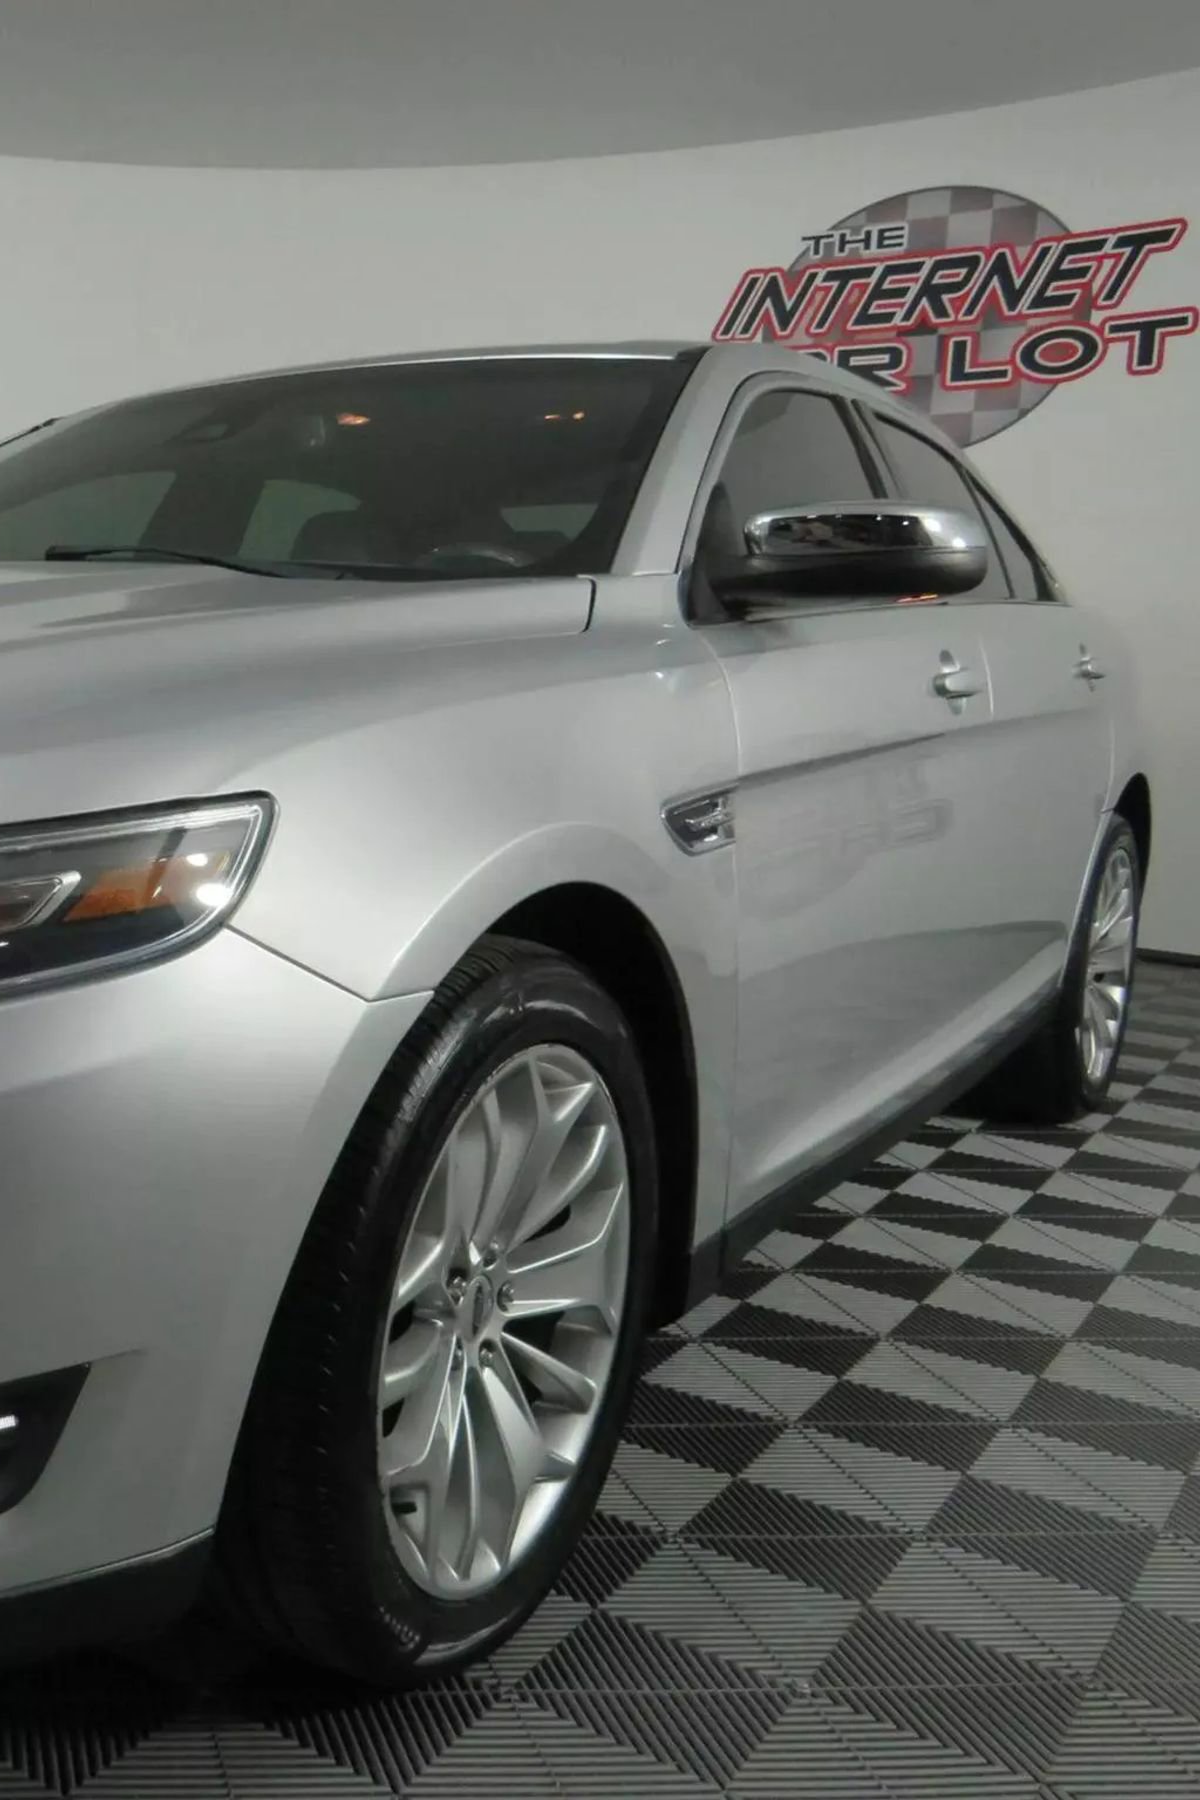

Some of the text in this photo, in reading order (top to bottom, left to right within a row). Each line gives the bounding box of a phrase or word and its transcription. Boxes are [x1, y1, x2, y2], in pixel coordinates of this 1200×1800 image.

[714, 220, 1187, 341] INTERNET
[801, 224, 908, 256] THE
[943, 308, 1198, 389] LOT
